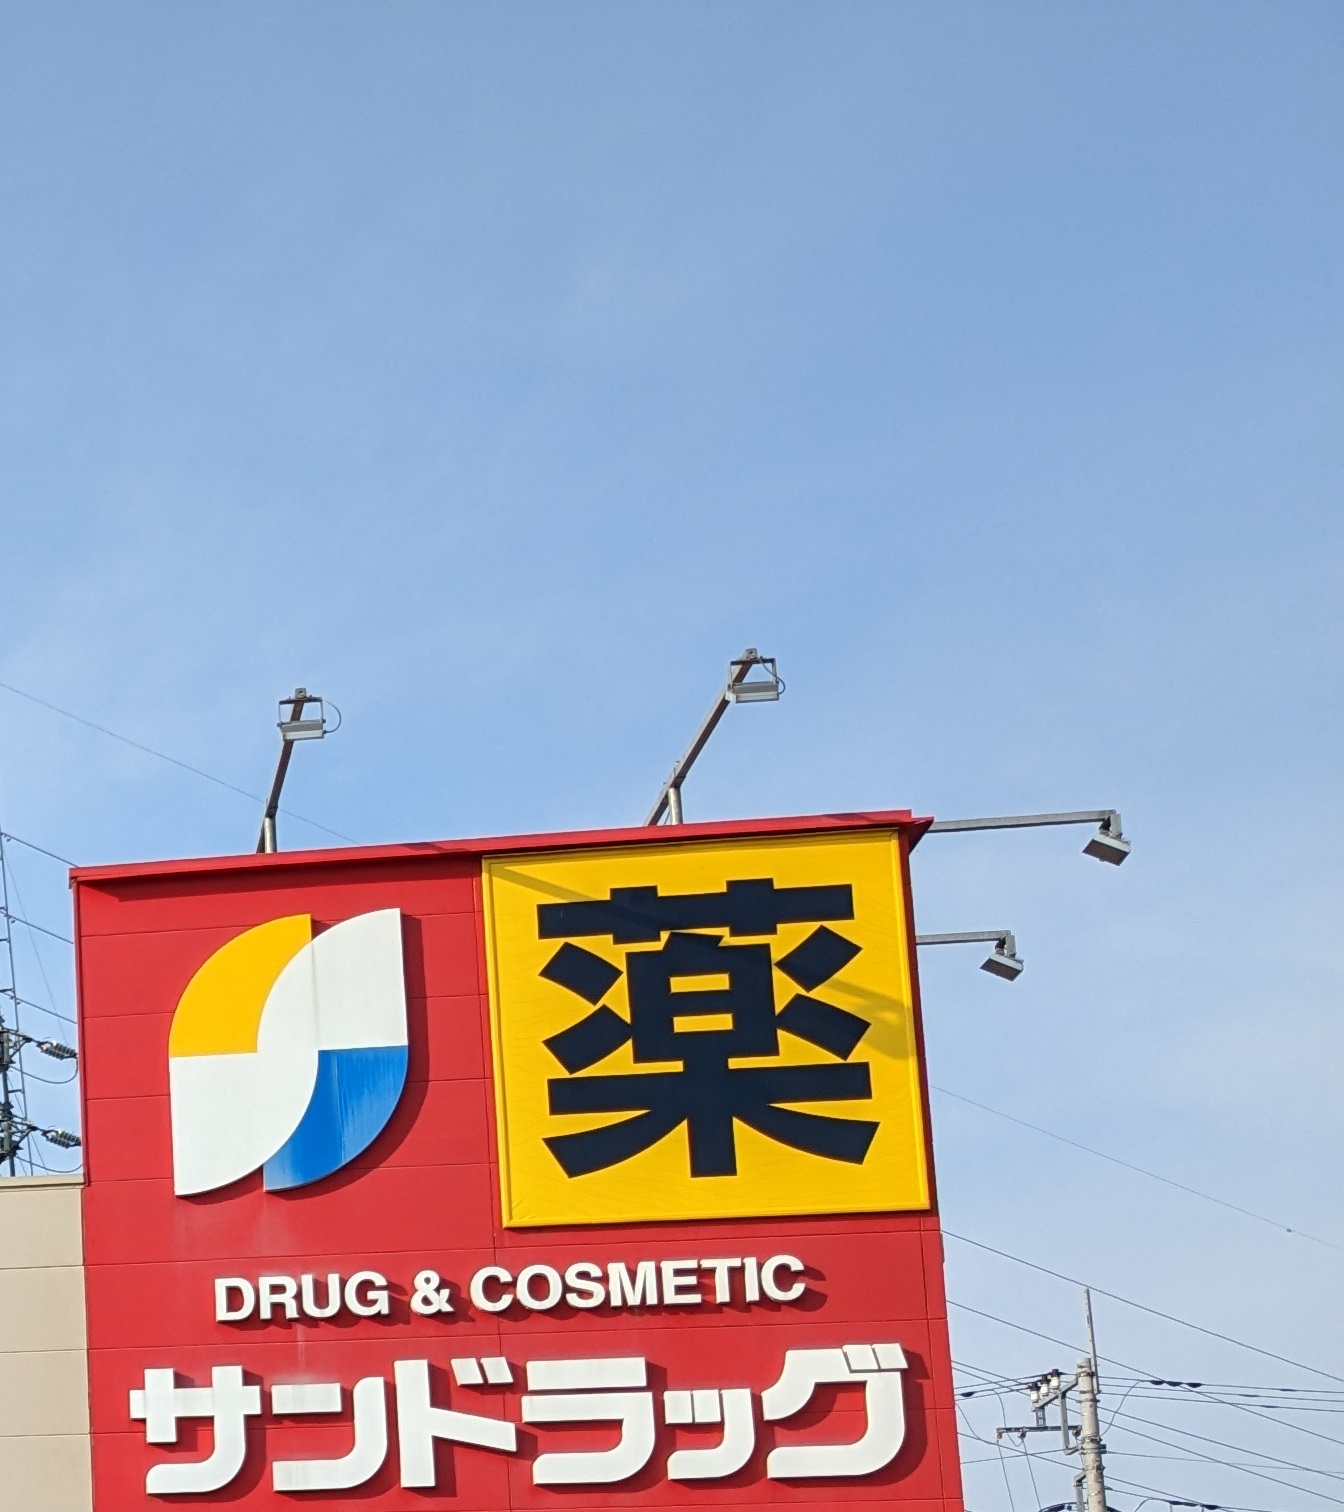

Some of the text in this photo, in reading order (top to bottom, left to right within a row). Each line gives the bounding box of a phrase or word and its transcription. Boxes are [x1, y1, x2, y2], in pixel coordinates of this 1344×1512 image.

[538, 877, 880, 1178] 薬
[214, 1254, 807, 1323] DRUG & COSMETIC
[129, 1343, 908, 1496] サンドラッグ
